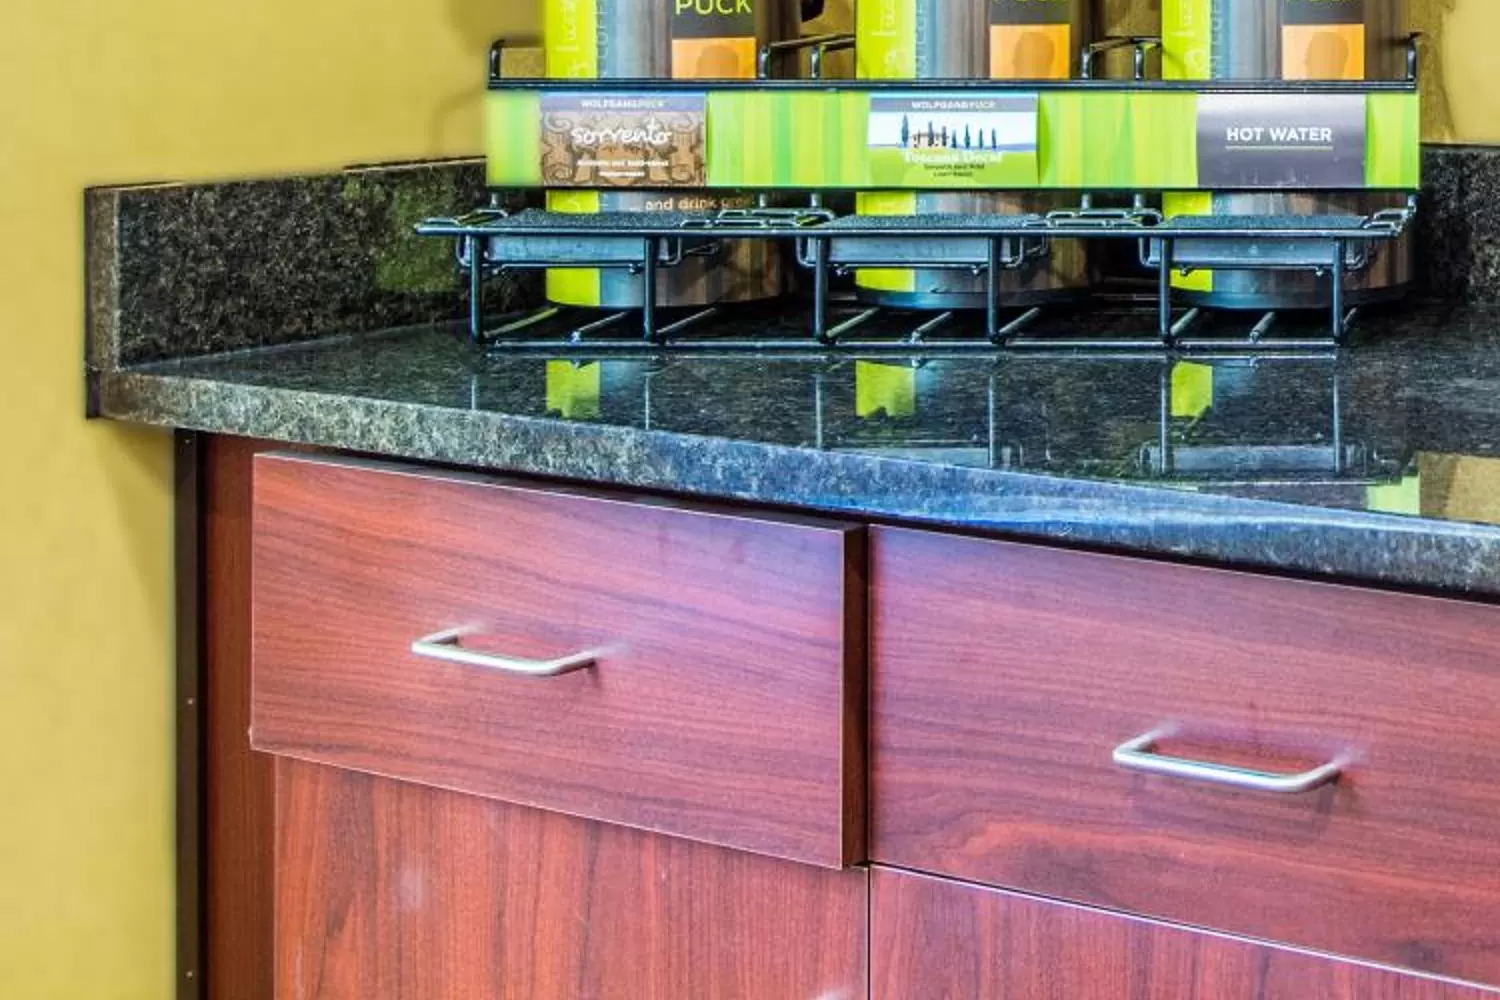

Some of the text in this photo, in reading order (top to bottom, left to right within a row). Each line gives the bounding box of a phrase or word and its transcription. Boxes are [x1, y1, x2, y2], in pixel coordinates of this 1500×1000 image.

[1226, 127, 1333, 142] HOT WATER
[645, 197, 673, 211] and
